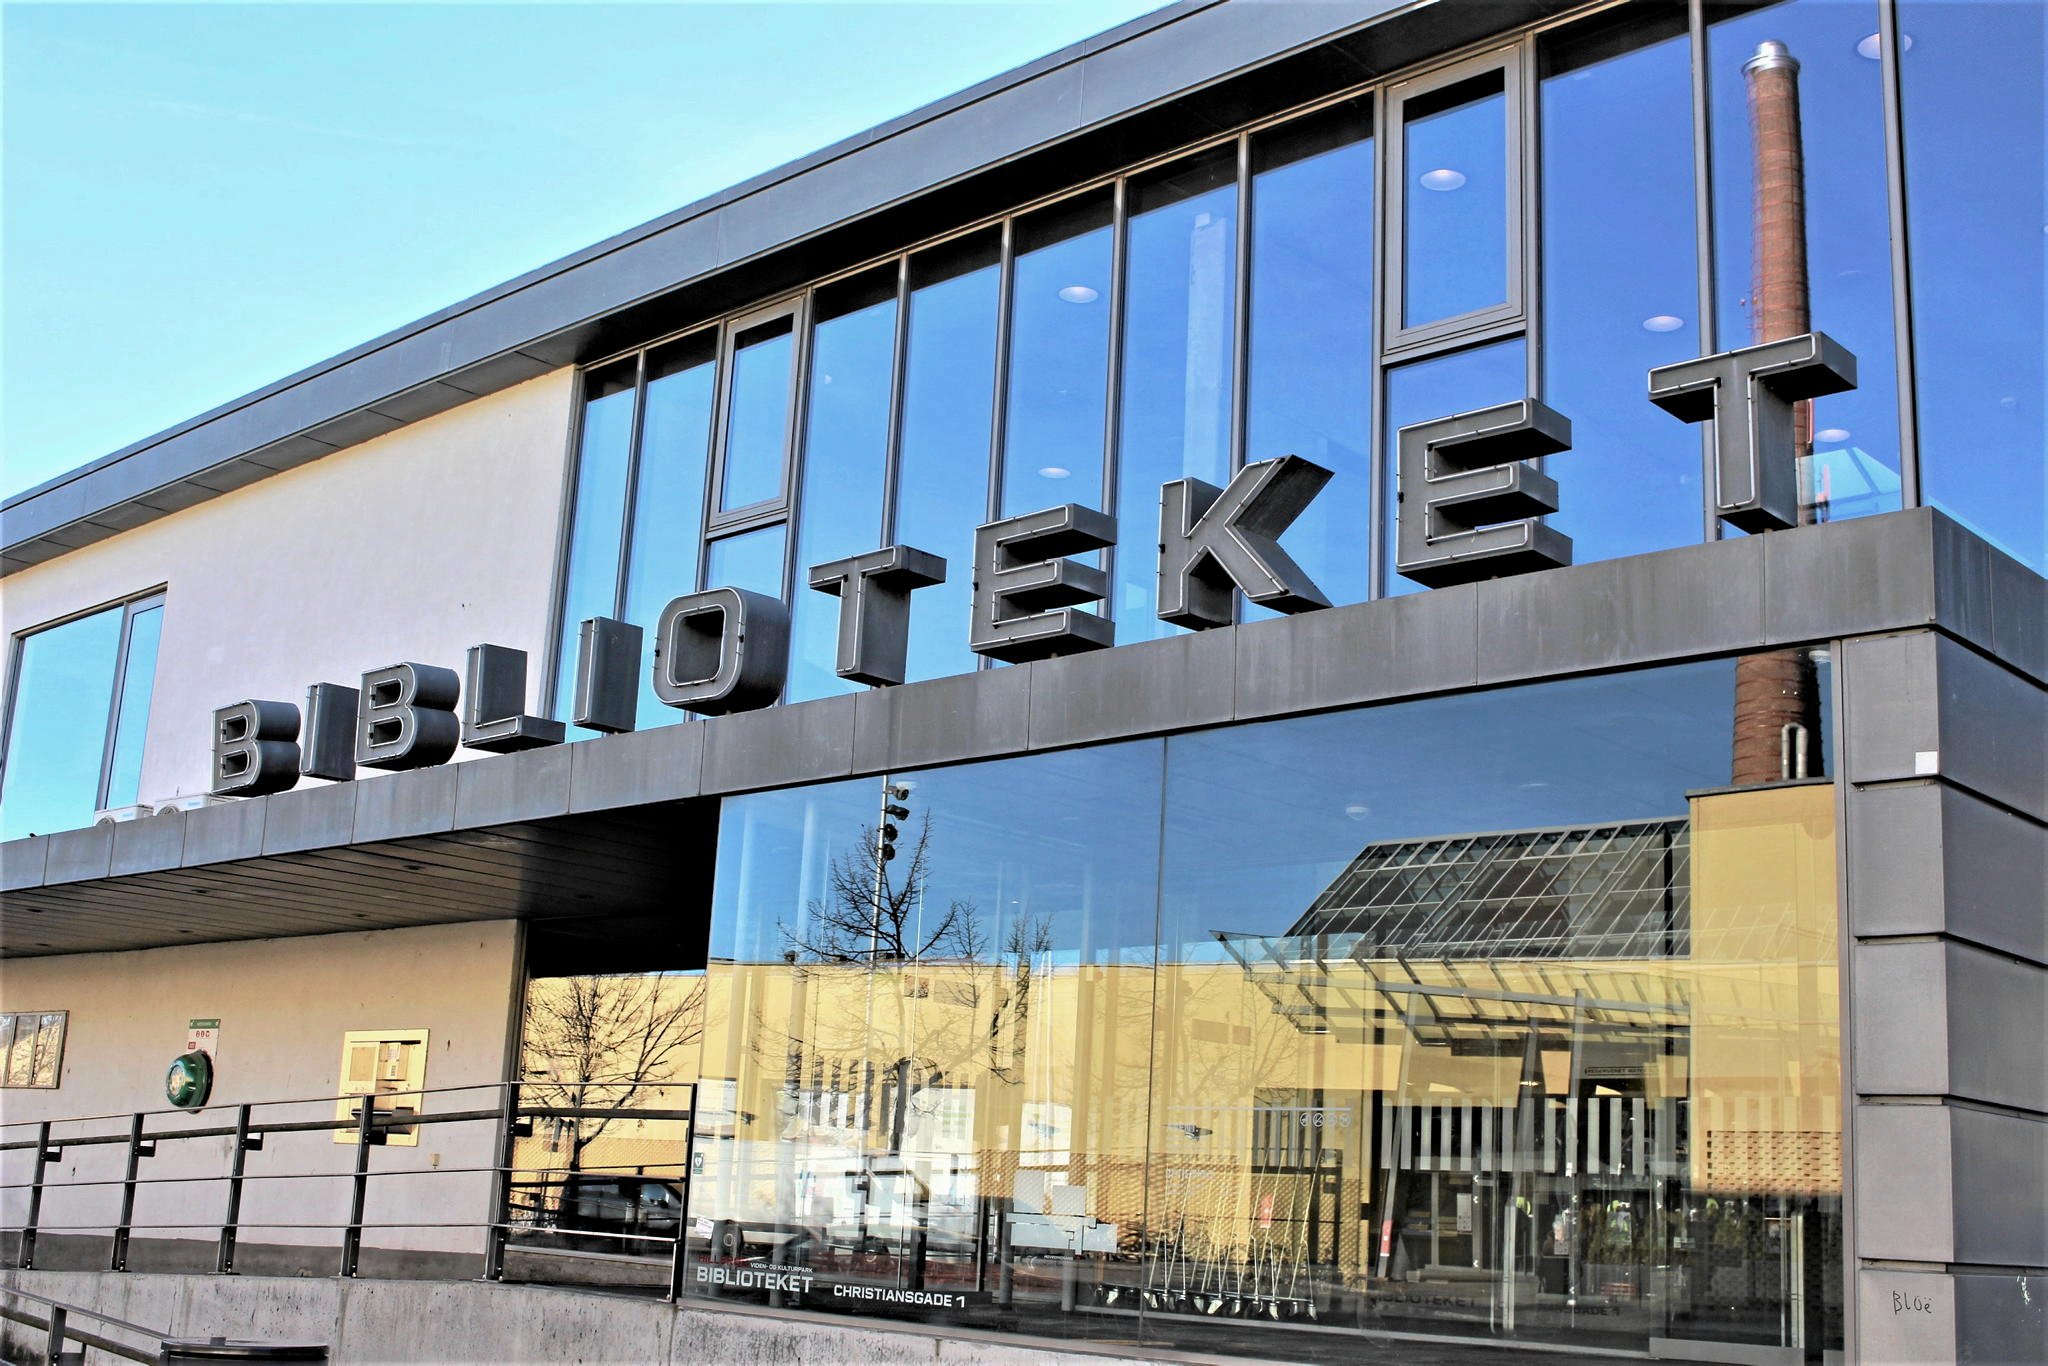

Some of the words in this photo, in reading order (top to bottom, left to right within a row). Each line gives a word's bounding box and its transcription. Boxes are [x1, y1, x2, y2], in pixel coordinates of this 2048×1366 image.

[211, 331, 1858, 797] BIBLIOTEKET
[697, 1266, 813, 1293] BIBLIOTEKET
[777, 1264, 813, 1274] KULTURPARK
[834, 1284, 952, 1307] CHRISTIANSGADE
[956, 1296, 965, 1308] 1
